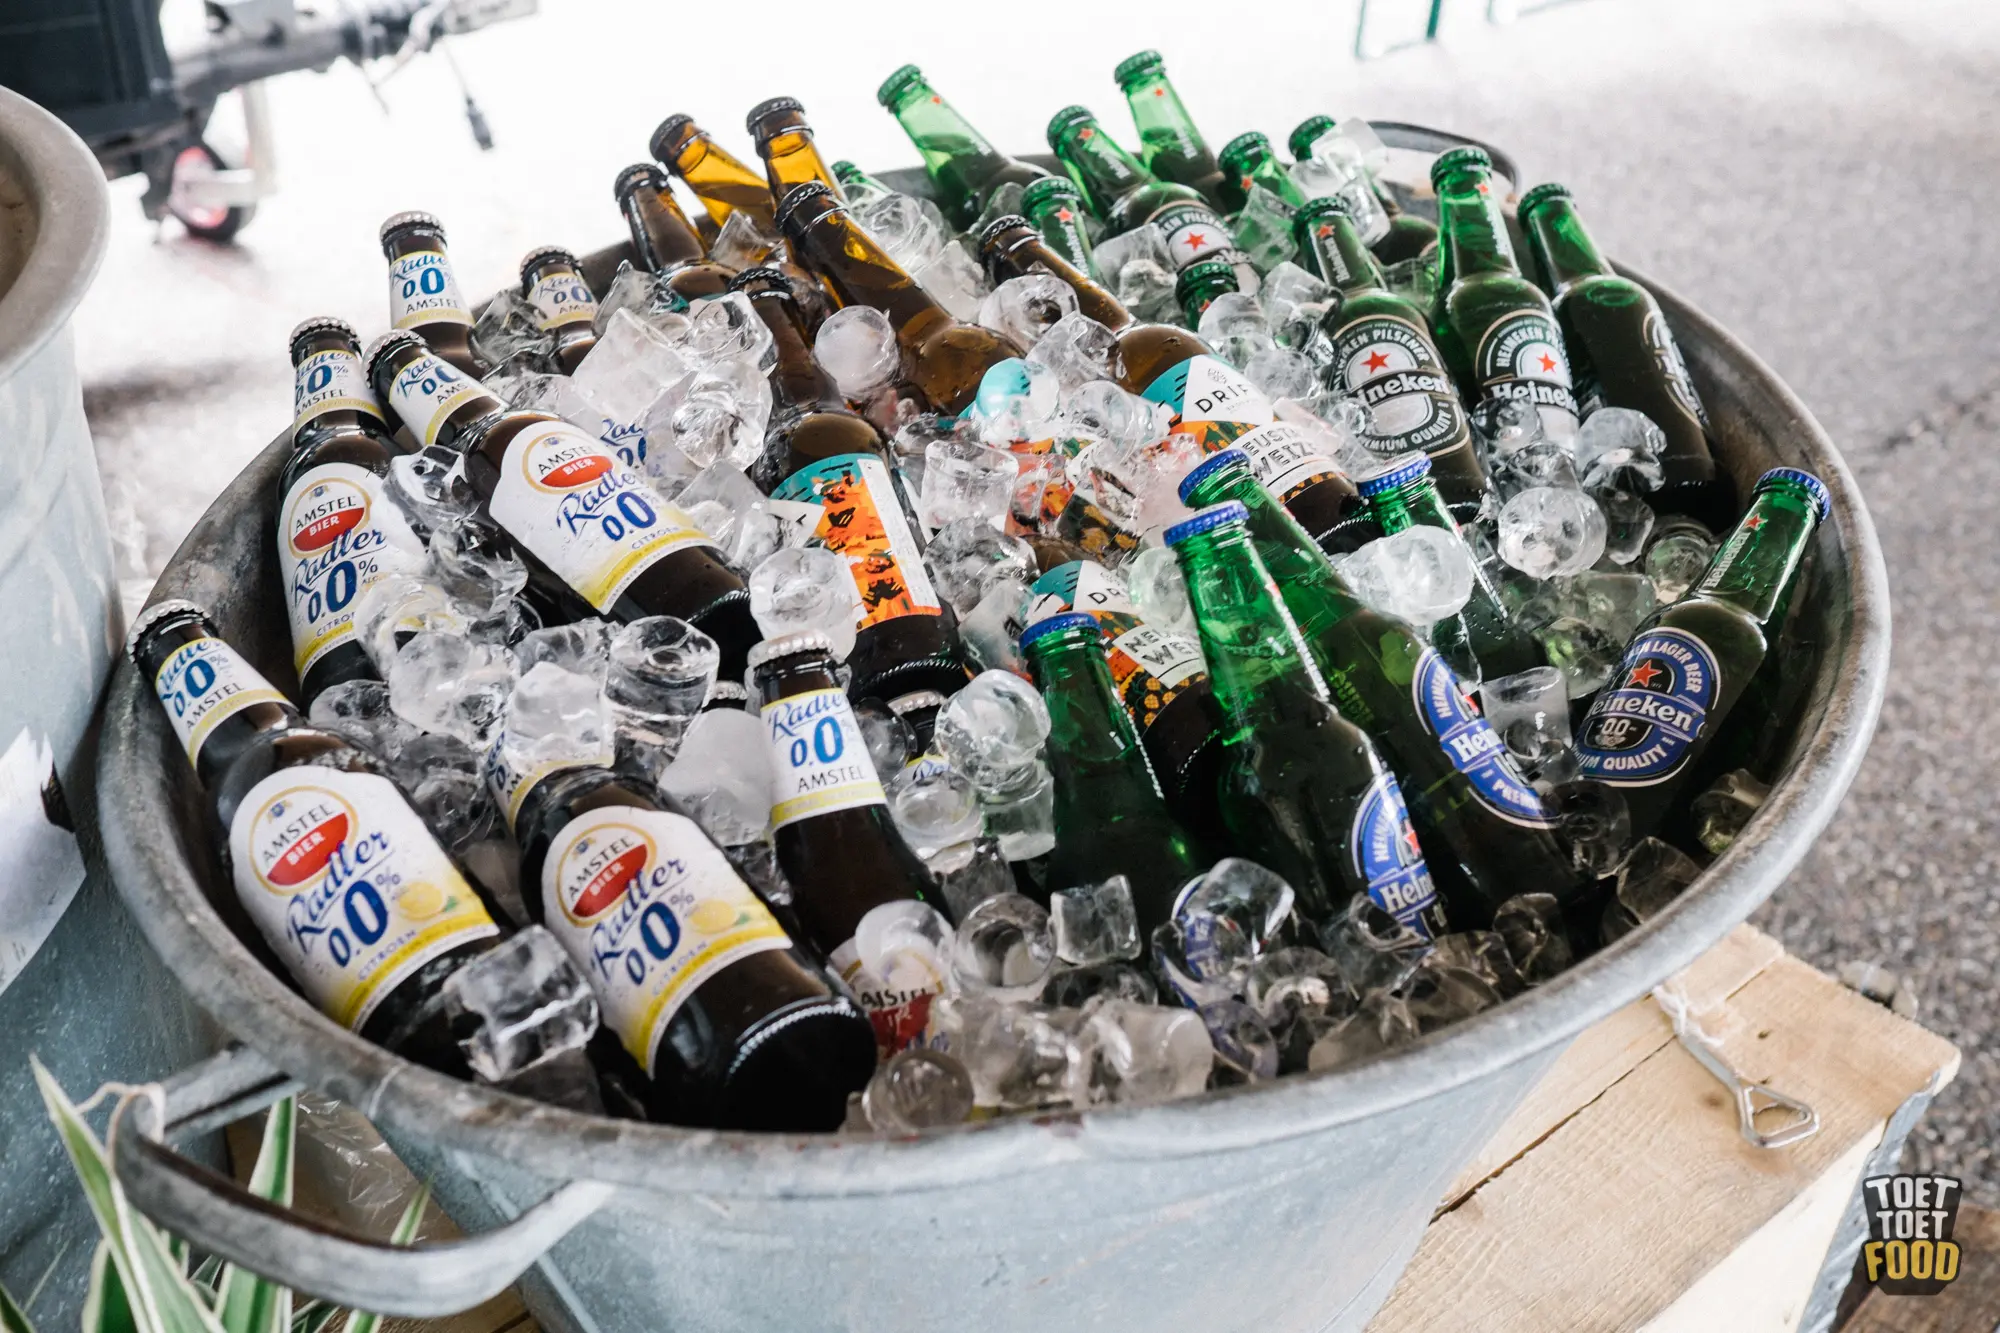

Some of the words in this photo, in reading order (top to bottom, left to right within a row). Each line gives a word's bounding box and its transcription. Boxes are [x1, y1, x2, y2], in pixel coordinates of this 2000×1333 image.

[1371, 328, 1431, 361] PILSENER
[1410, 408, 1452, 444] QUALITY
[562, 457, 596, 476] BIER
[295, 496, 357, 533] AMSTEL
[309, 515, 340, 537] BIER
[291, 528, 388, 607] Radler
[1651, 640, 1693, 664] LAGER
[1683, 661, 1703, 694] BEER
[186, 682, 246, 732] AMSTEL
[1602, 743, 1669, 771] QUALITY
[798, 765, 867, 793] AMSTEL
[263, 803, 334, 865] AMSTEL
[286, 831, 326, 866] BIER
[569, 836, 635, 898] AMSTEL
[588, 861, 625, 897] BIER
[287, 830, 392, 956] Radler
[590, 857, 688, 984] Radler
